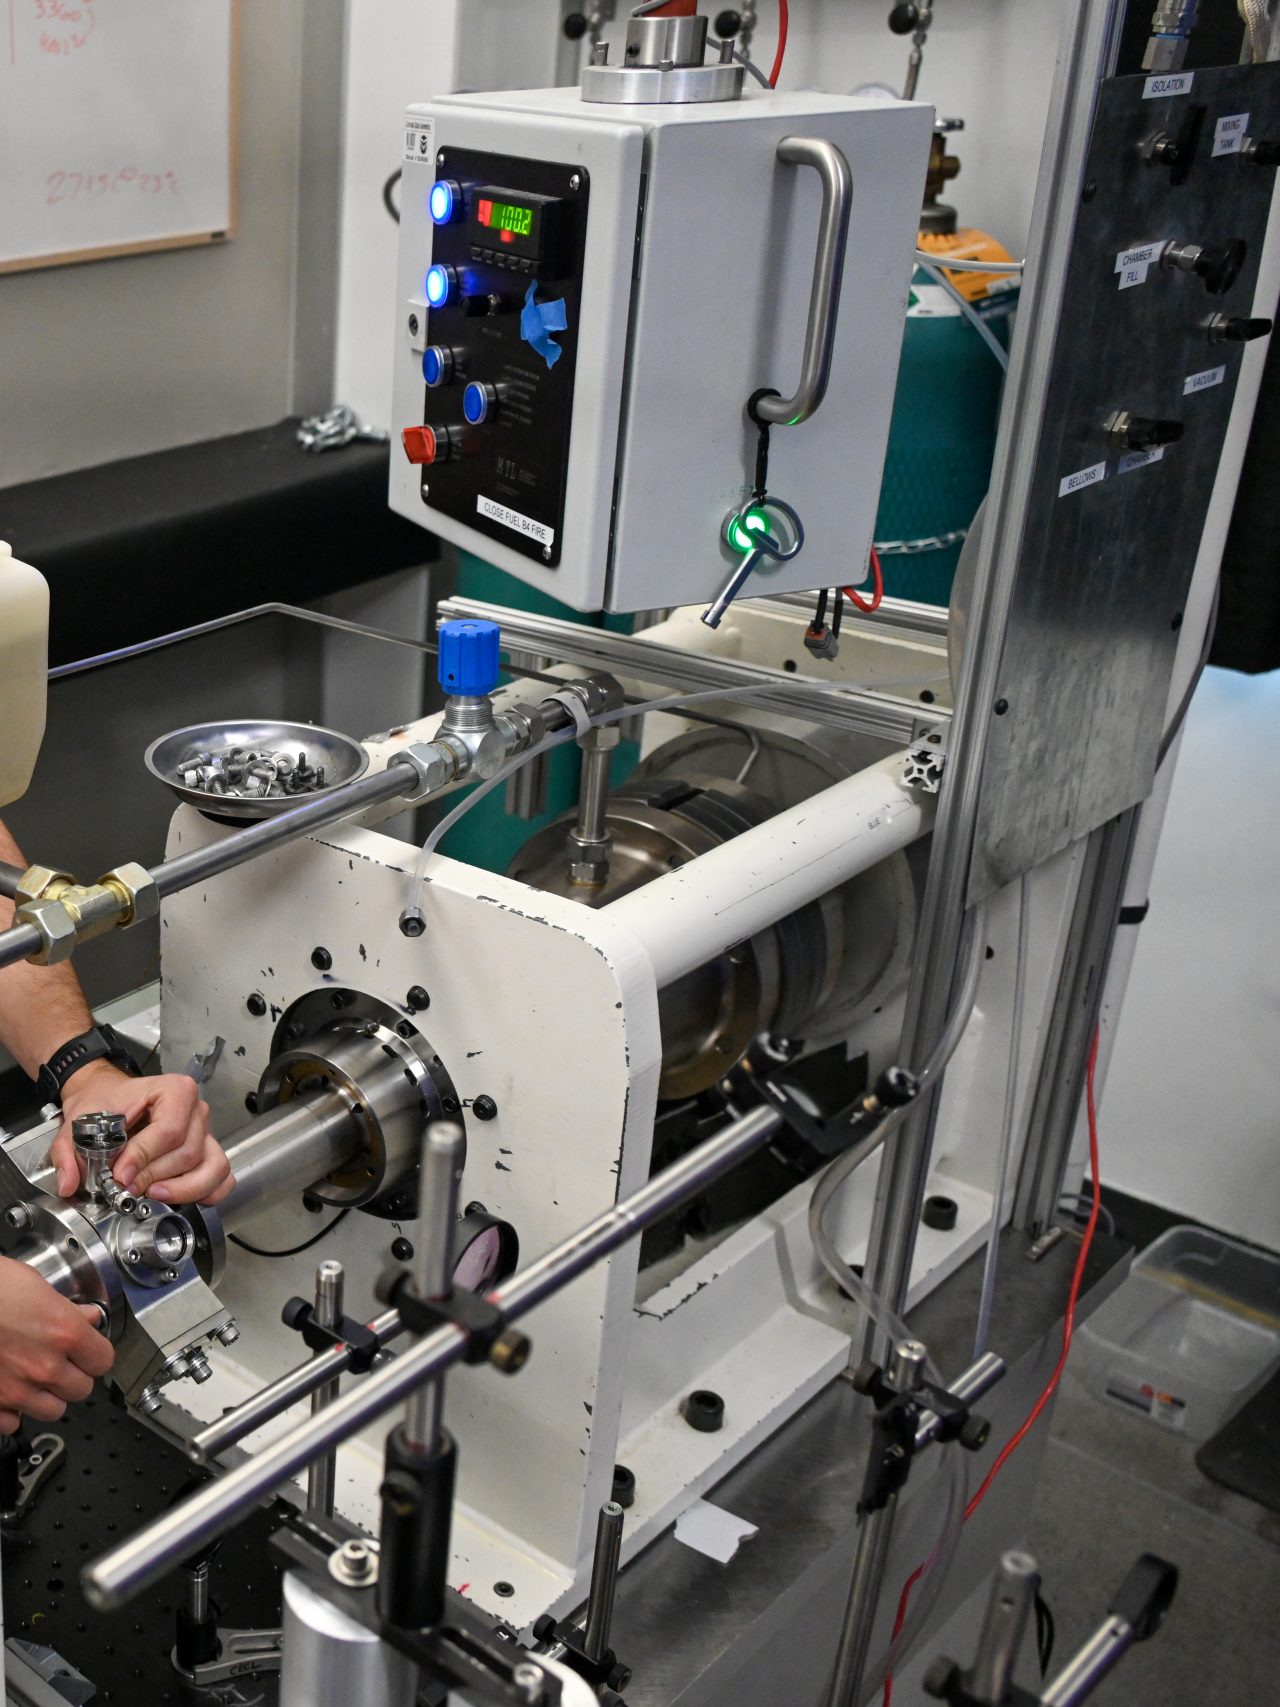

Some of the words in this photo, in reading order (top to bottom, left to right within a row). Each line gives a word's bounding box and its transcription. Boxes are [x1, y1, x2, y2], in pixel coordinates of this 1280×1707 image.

[1151, 79, 1185, 93] ISOLATION
[1222, 120, 1240, 132] MIXING
[1220, 138, 1235, 150] TANK
[1122, 248, 1153, 266] CHAMBER
[1127, 271, 1138, 282] FILL
[1192, 371, 1218, 388] VACUUM
[1067, 468, 1097, 489] BELLOWS
[484, 502, 504, 520] CLOSE
[505, 512, 520, 528] FUEL
[522, 520, 530, 531] B4
[531, 525, 546, 540] FIRE
